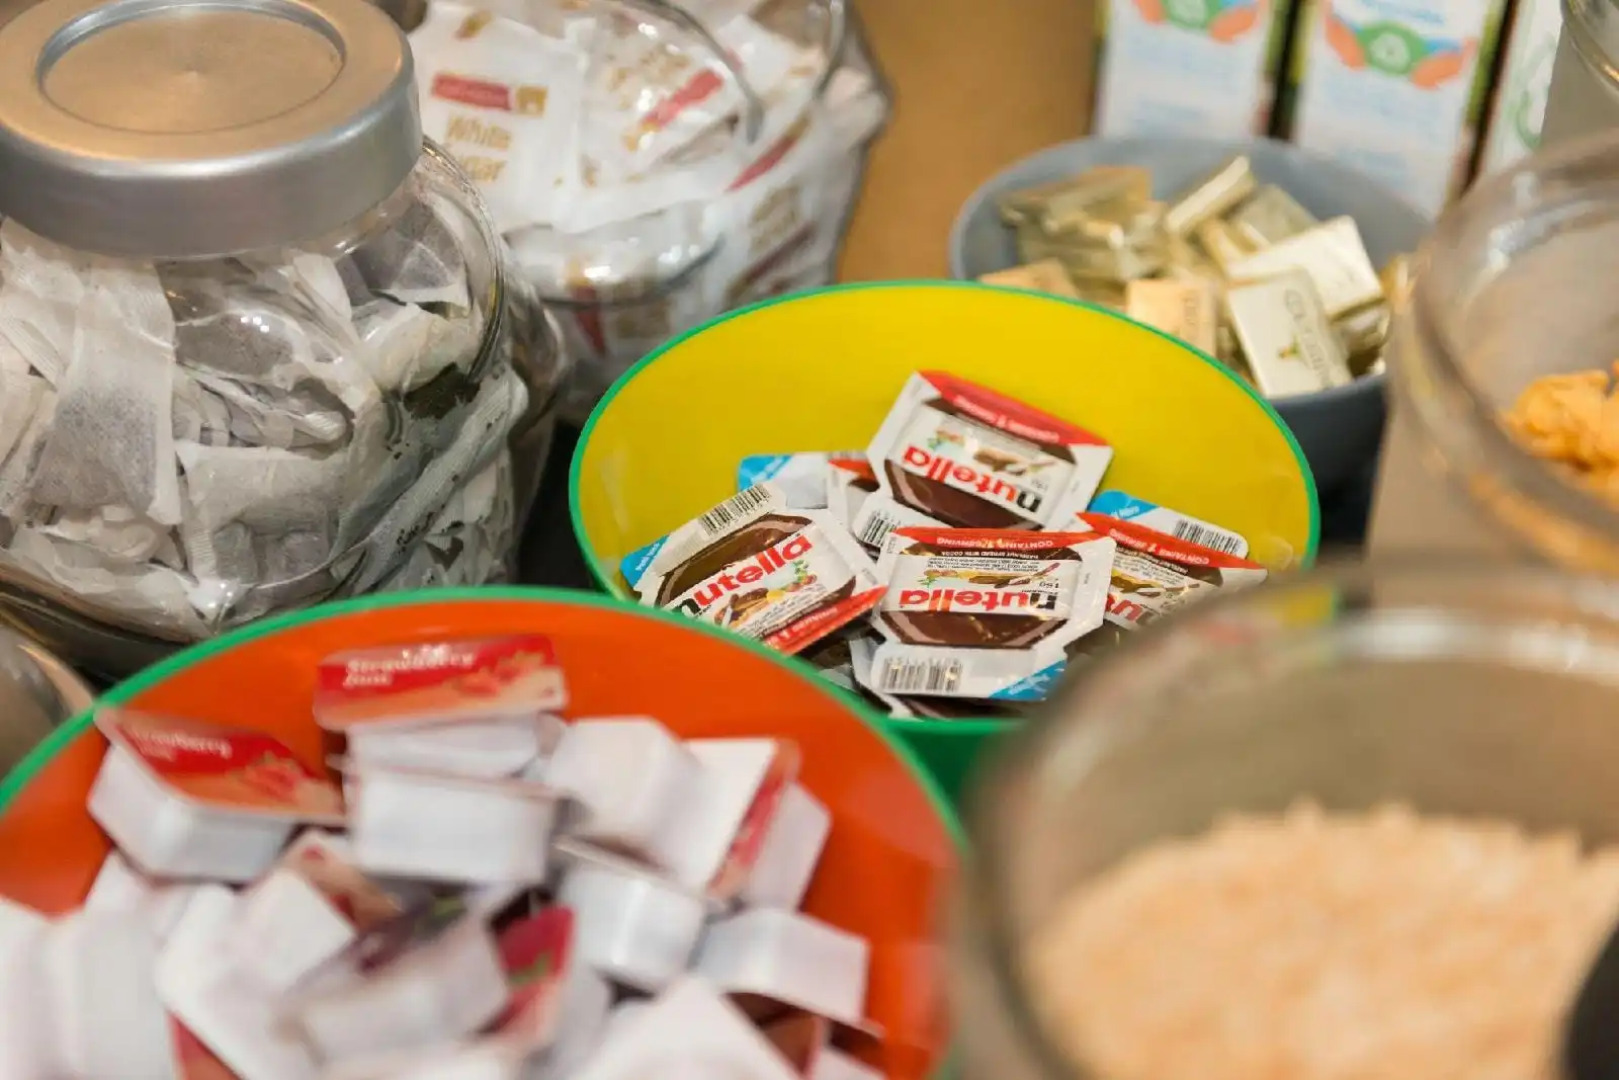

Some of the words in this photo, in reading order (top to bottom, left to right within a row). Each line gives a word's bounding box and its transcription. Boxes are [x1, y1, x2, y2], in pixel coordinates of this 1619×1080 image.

[446, 115, 511, 150] White
[460, 154, 506, 182] ugar
[903, 446, 1044, 513] nutella
[675, 534, 813, 618] nutella
[898, 588, 1059, 612] nutella
[345, 648, 474, 674] Strawberry
